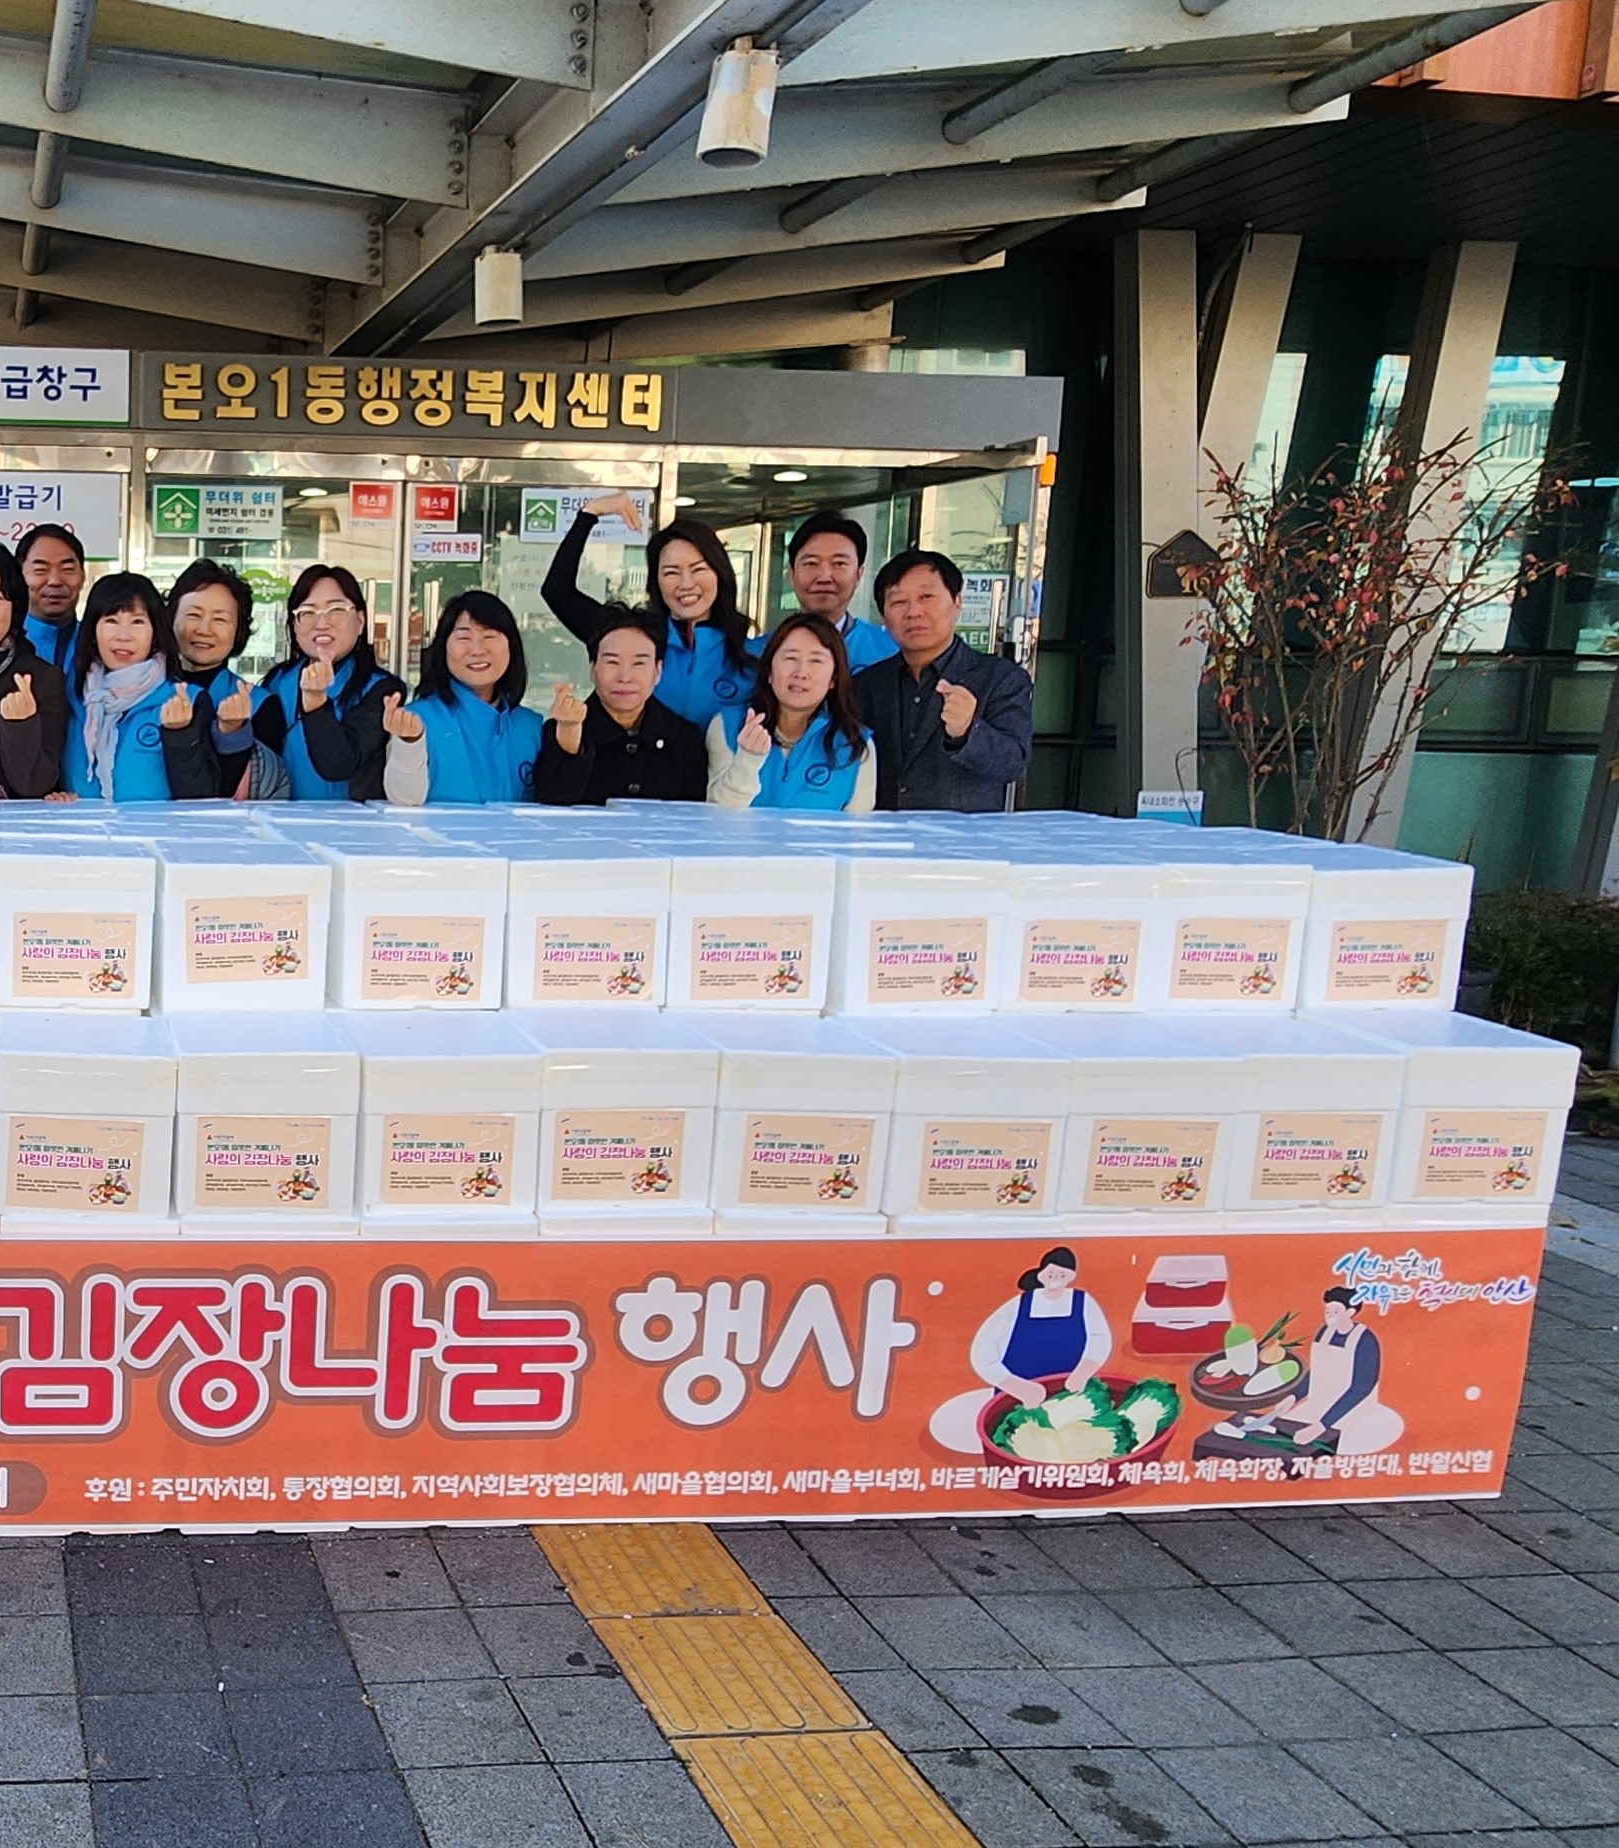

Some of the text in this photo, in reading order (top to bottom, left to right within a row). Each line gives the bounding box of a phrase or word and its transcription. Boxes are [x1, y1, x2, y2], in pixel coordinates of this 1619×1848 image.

[162, 362, 662, 431] 본오1동행정복지센터
[205, 490, 244, 505] 무더위
[420, 496, 450, 510] 에스원
[431, 541, 452, 555] CCTV
[1481, 1276, 1534, 1305] 안산
[614, 1275, 917, 1427] 행사
[85, 1450, 1493, 1502] 후원 주민자치회, 통장협의회, 지역사회보장협의체, 새마을협의회, 새마을부녀회, 바르게살기위원회, 체육회, 체육회장, 자율방범대, 반월신협
